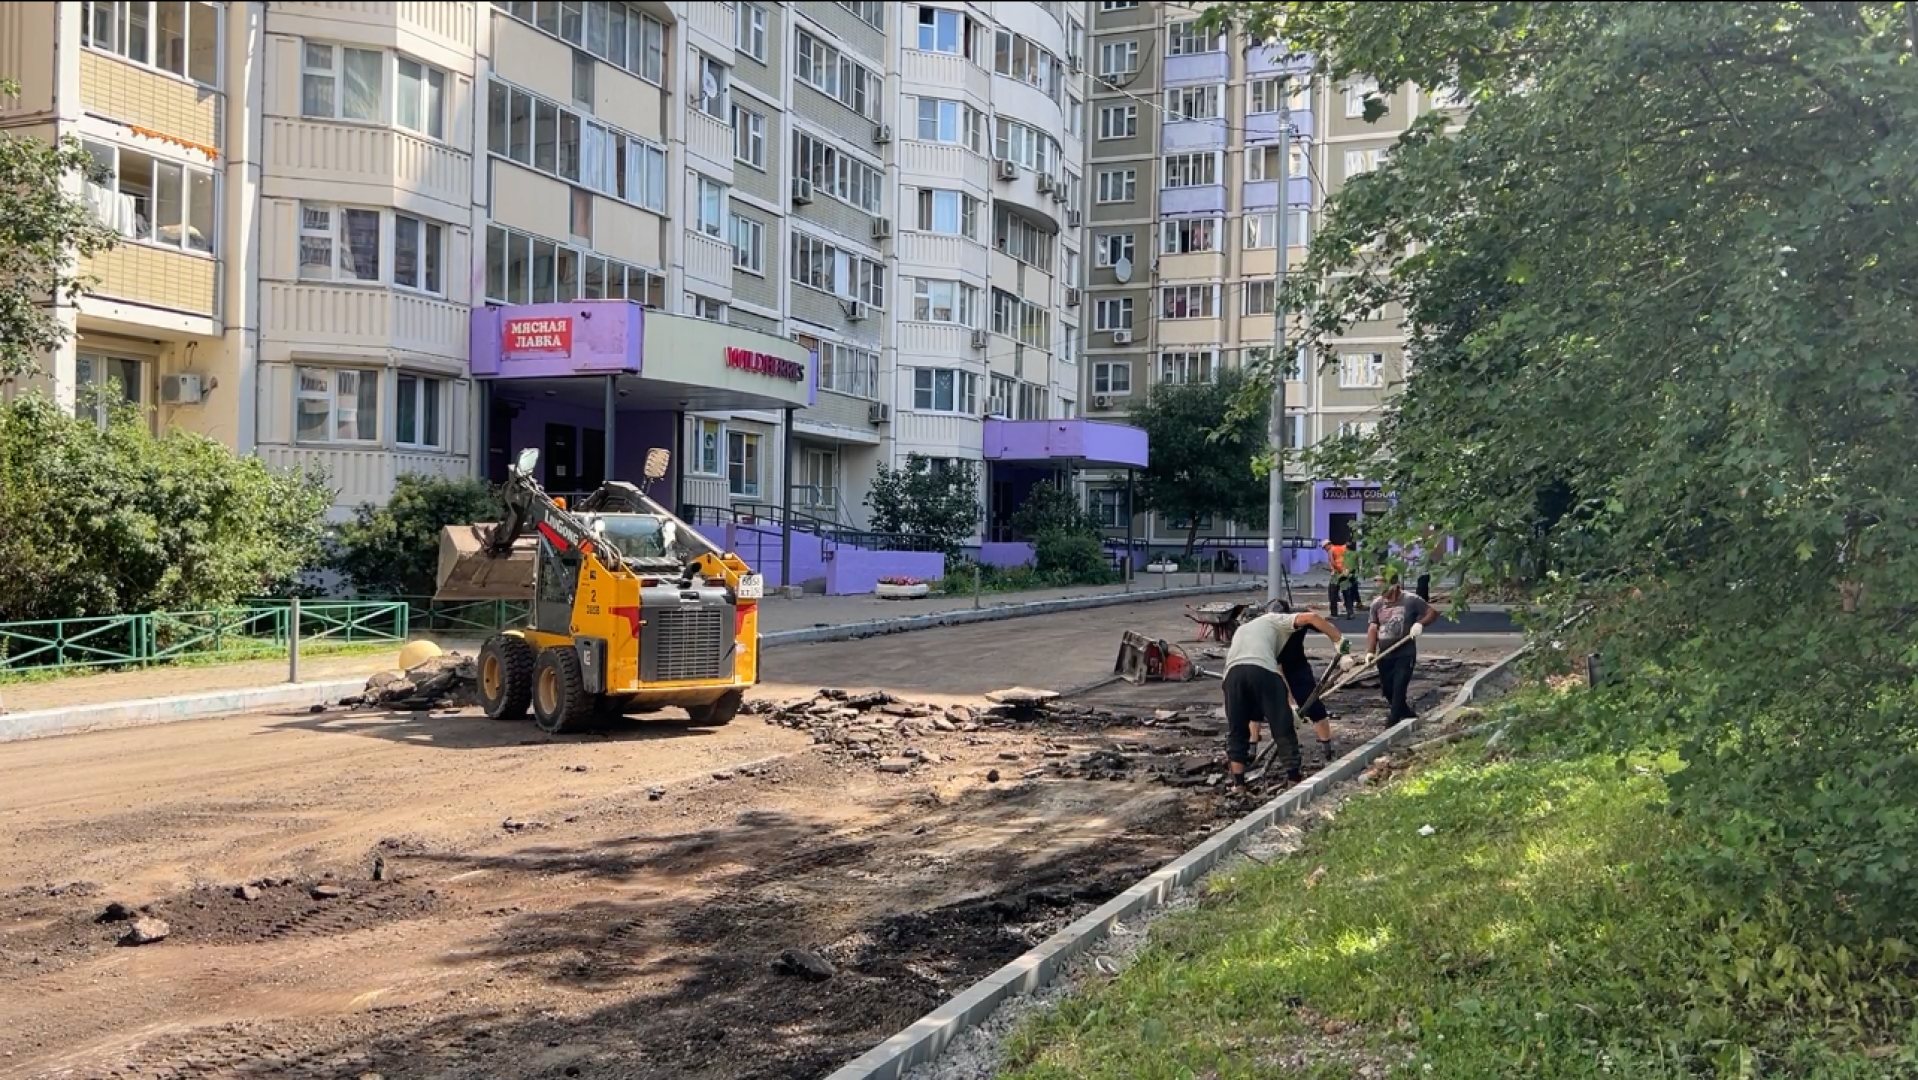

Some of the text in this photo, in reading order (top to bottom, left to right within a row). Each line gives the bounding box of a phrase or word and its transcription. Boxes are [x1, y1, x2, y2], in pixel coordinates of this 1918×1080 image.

[511, 320, 567, 334] МЯСНАЯ
[515, 334, 562, 348] ЛАВКА
[1324, 489, 1348, 500] УХОД
[1350, 489, 1362, 498] ЗА
[590, 589, 597, 603] 2
